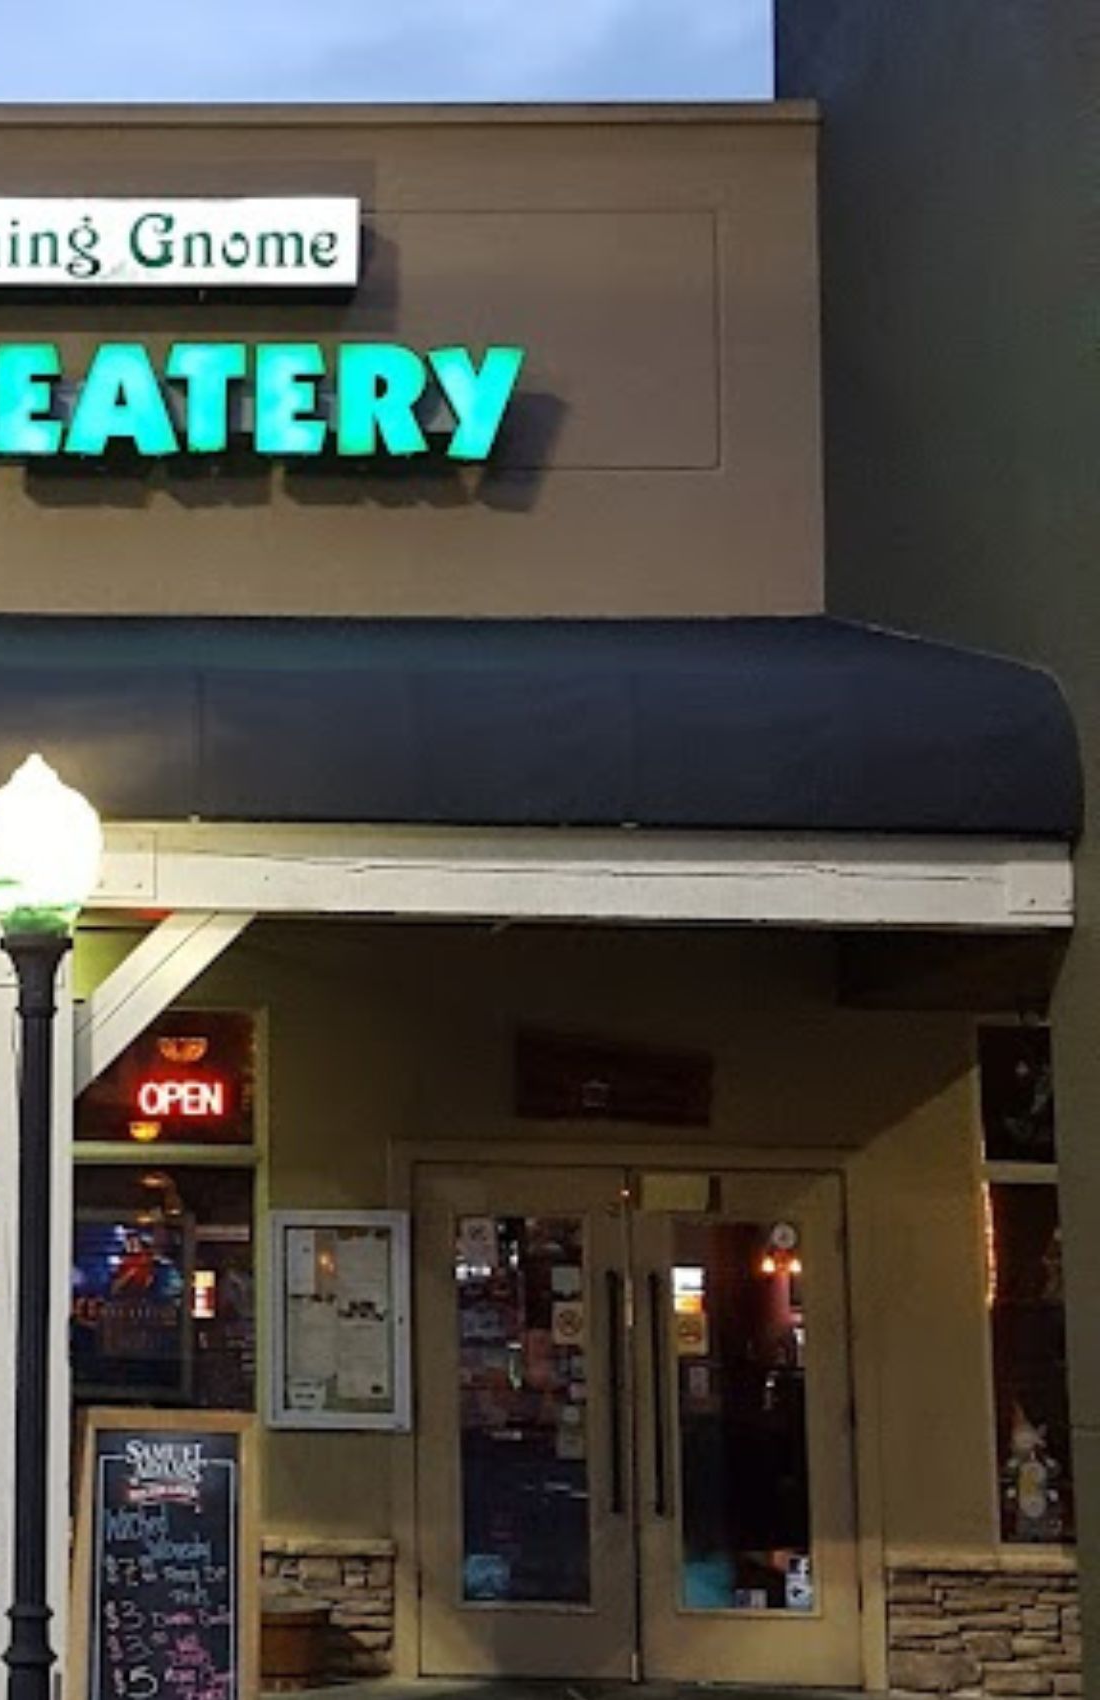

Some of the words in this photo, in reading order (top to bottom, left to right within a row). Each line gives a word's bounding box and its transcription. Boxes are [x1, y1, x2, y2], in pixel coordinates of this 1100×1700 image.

[129, 211, 340, 267] Gnome
[138, 1081, 223, 1115] OPEN
[125, 1440, 203, 1464] SAMUEL
